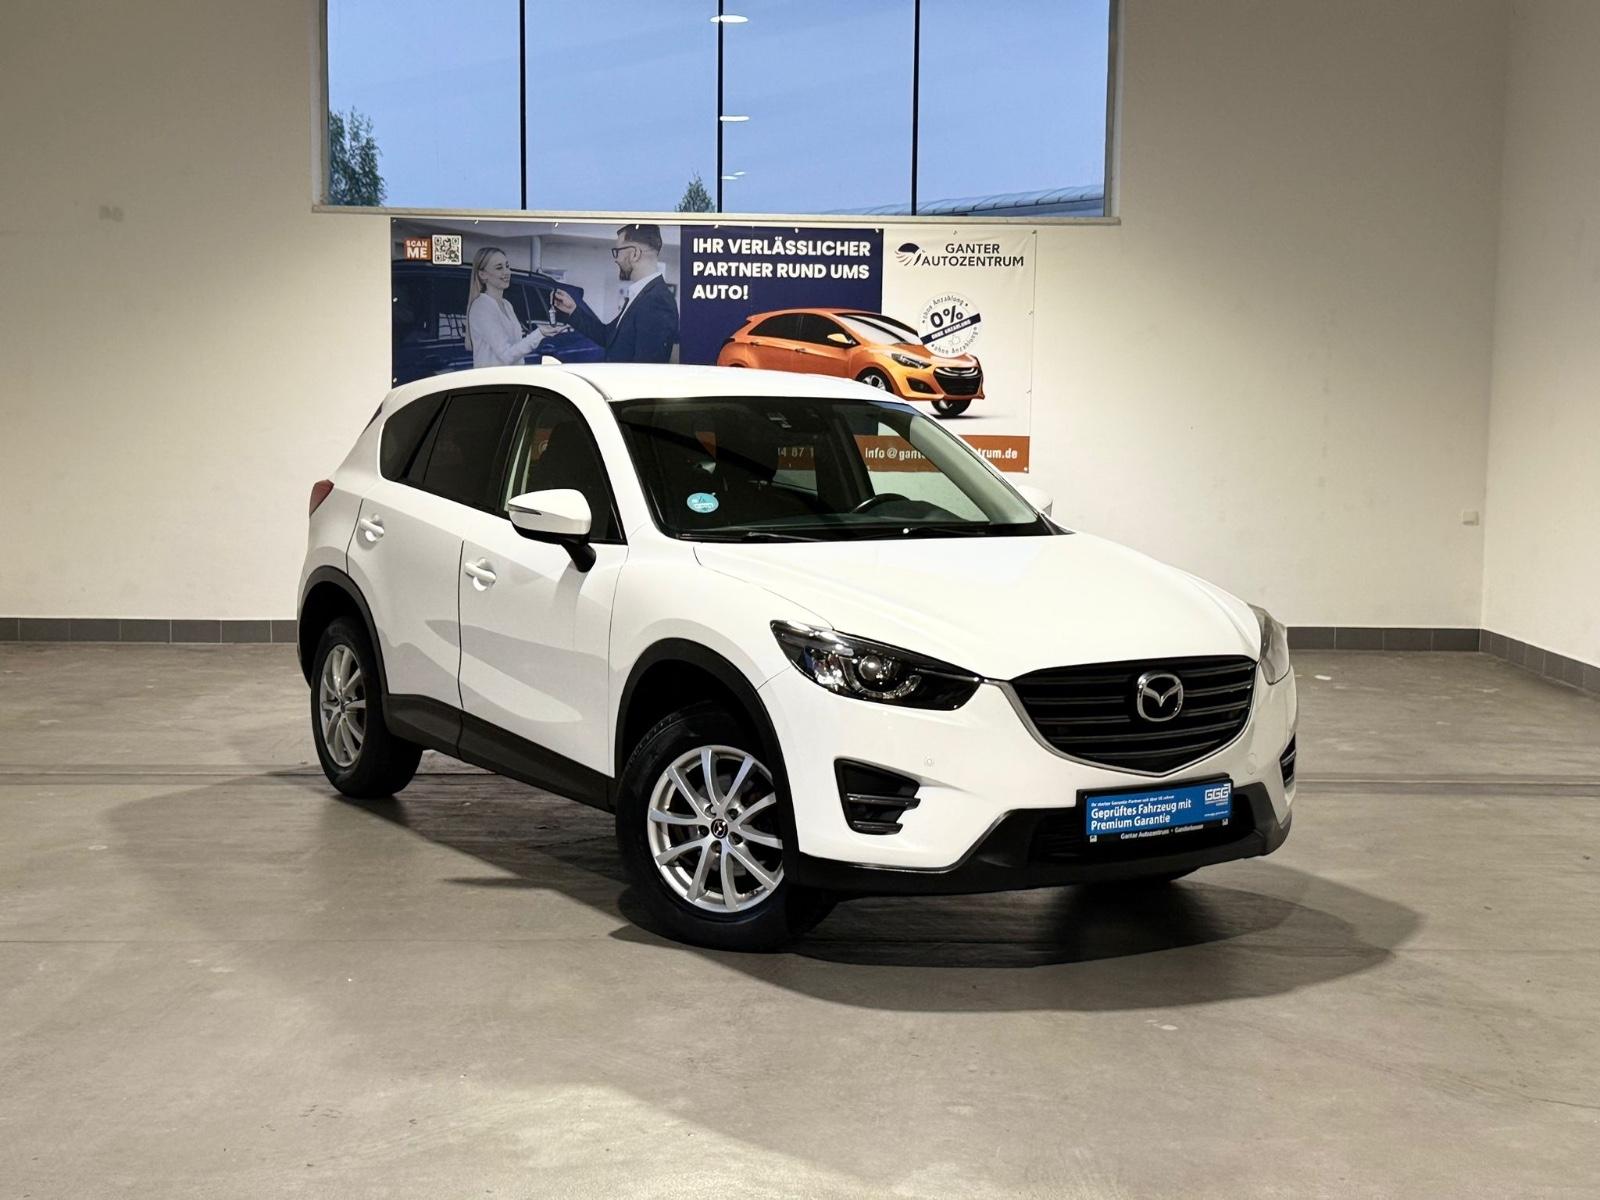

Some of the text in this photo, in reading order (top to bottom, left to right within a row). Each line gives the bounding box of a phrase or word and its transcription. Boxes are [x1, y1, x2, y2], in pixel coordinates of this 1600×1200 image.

[406, 240, 428, 248] SCAN
[693, 236, 871, 257] IHR VERLÄSSLICHER
[945, 243, 1000, 254] GANTER
[406, 247, 428, 259] ME
[921, 256, 1025, 267] AUTOZENTRUM
[693, 262, 870, 279] PARTNER RUND UMS
[692, 284, 749, 300] AUTO!
[930, 304, 964, 329] 0%
[1204, 787, 1229, 801] GGG
[1091, 798, 1192, 820] Geprüftes Fahrzeug mit
[1091, 812, 1171, 831] Premium Garantie
